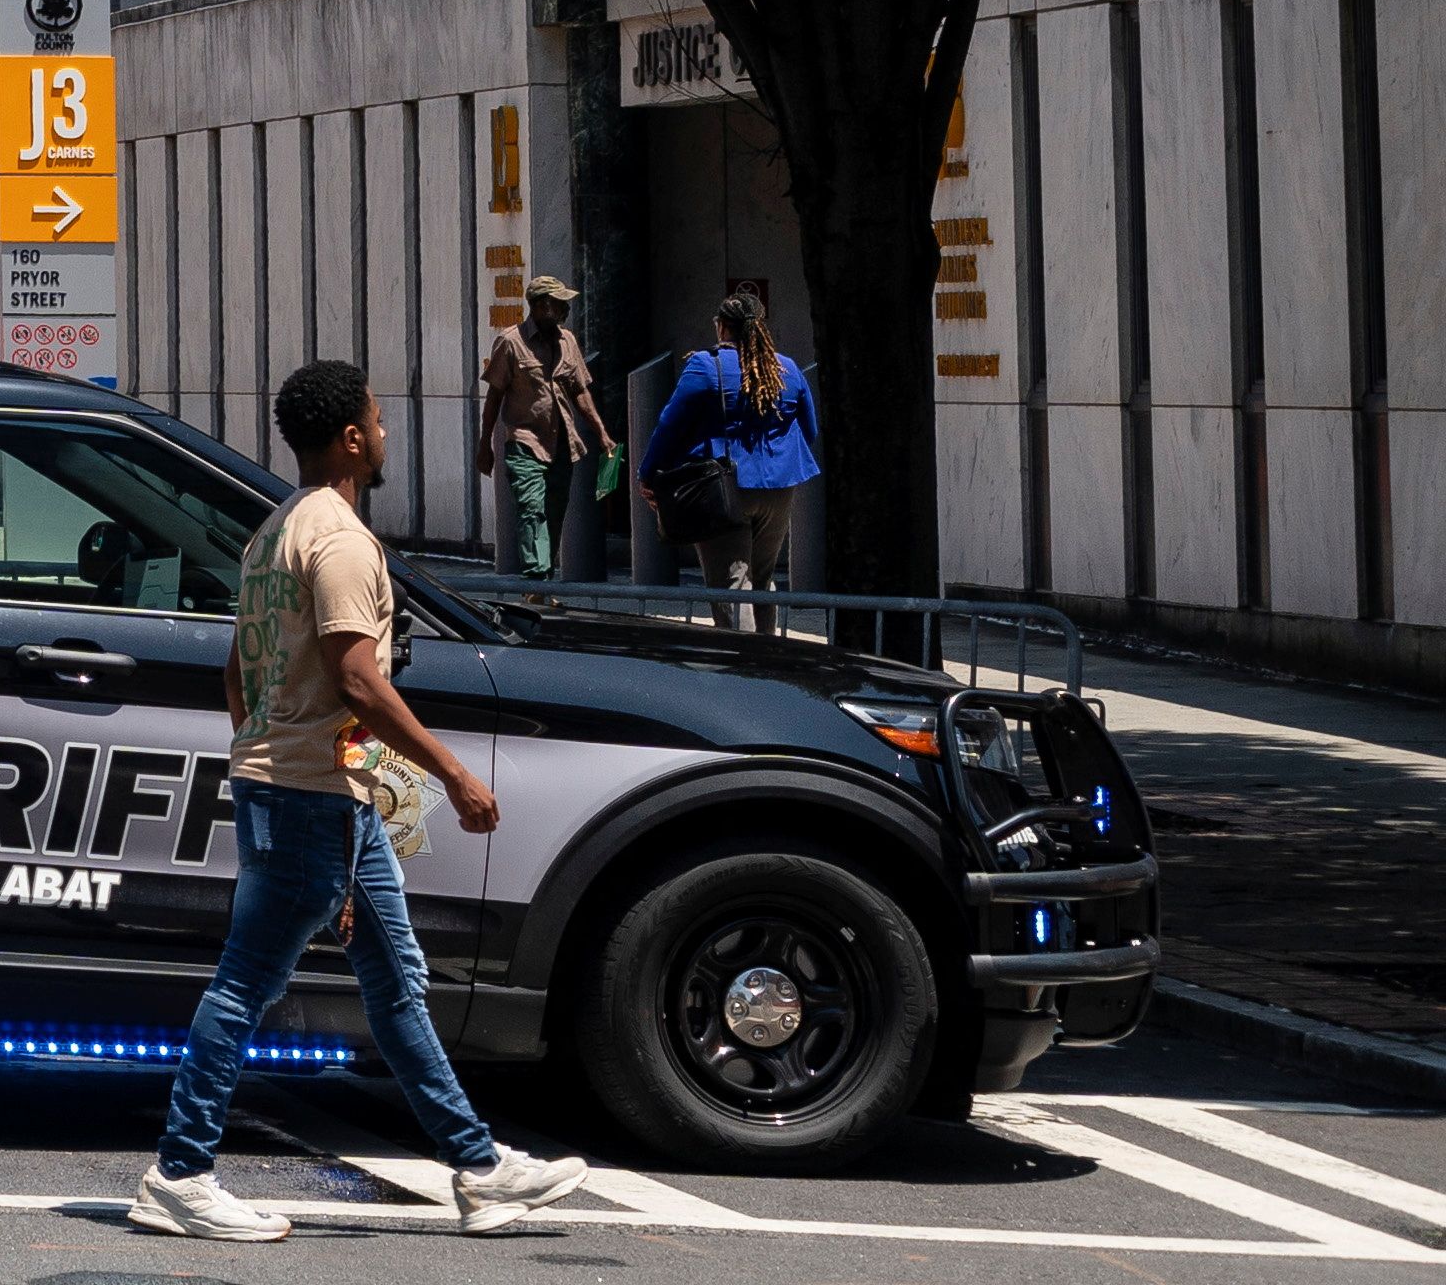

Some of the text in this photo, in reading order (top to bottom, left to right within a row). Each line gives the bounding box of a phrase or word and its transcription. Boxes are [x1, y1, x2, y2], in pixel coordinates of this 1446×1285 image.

[35, 32, 74, 42] FULTON
[35, 41, 75, 51] COUNTY
[633, 22, 721, 88] JUSTICE
[19, 67, 88, 161] J3
[47, 146, 95, 159] CARNES
[11, 249, 41, 264] 160
[11, 271, 60, 286] PRYOR
[10, 292, 67, 307] STREET
[380, 761, 416, 789] COUNTY
[390, 823, 414, 845] FFICE
